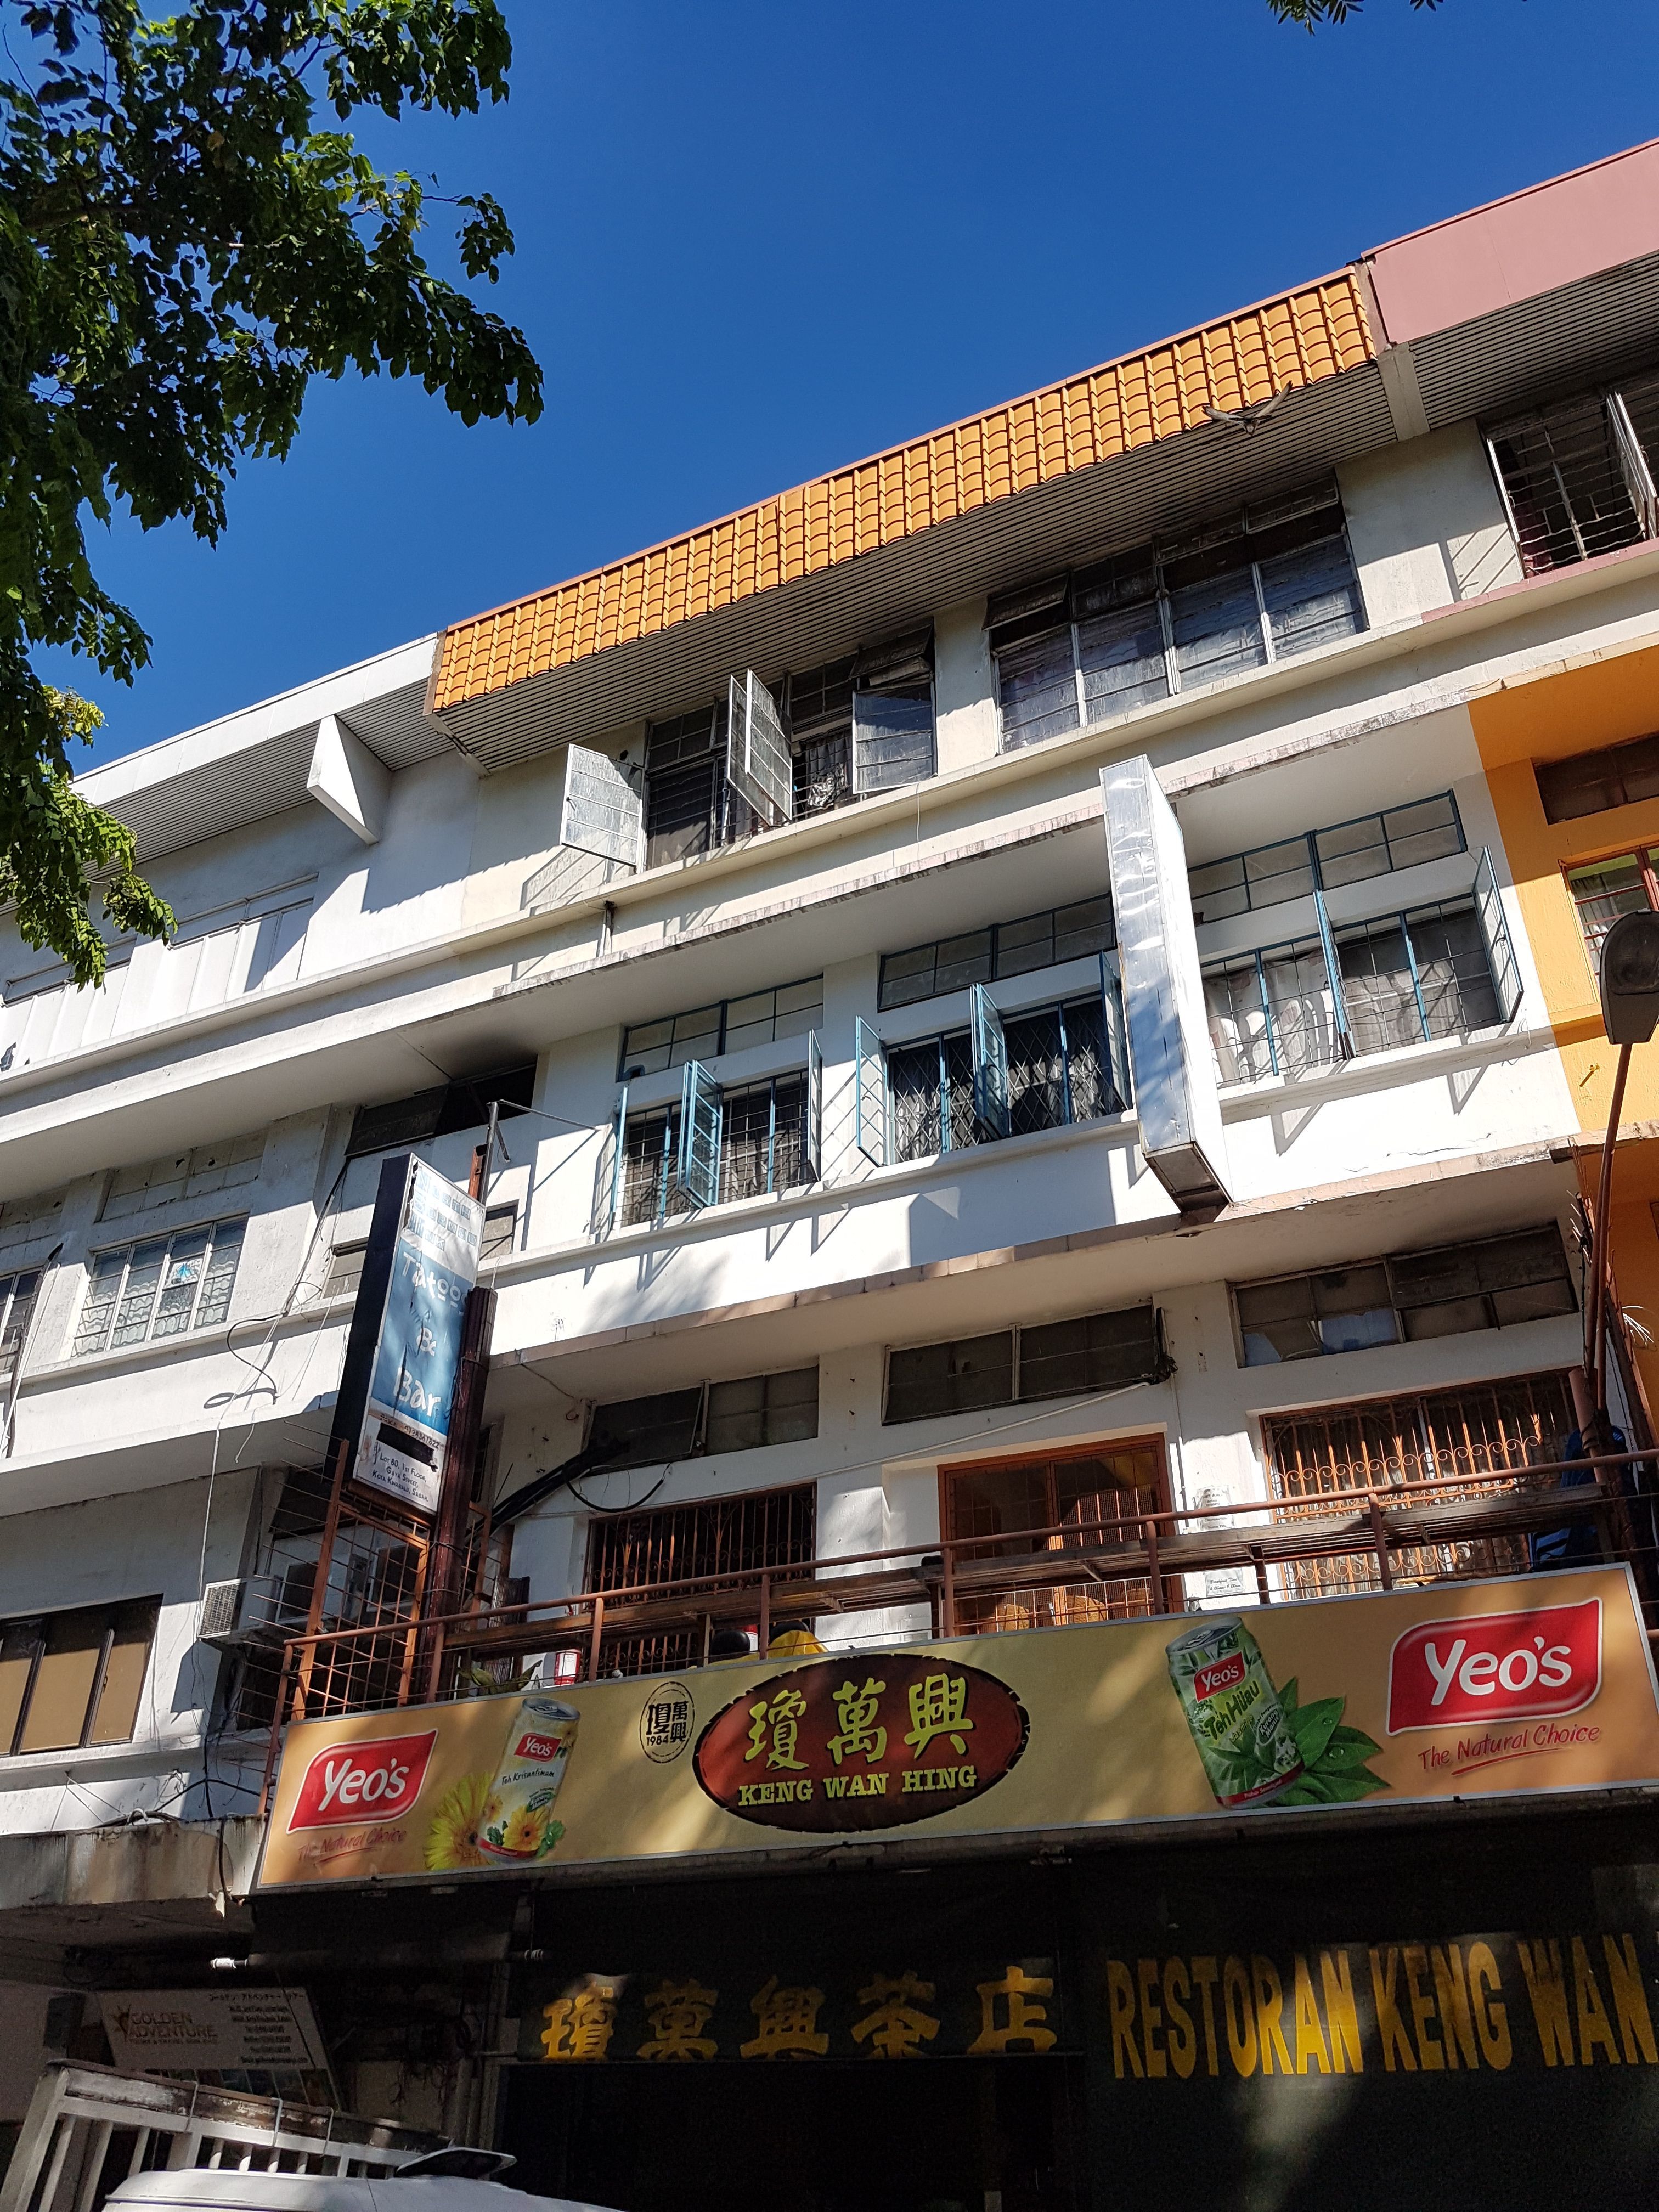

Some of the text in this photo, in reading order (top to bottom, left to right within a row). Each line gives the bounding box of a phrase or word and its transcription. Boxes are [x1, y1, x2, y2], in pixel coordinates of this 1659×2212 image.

[415, 1169, 471, 1221] NORTH
[412, 1189, 477, 1246] BORNEO
[416, 1327, 437, 1357] &
[393, 1367, 441, 1417] Bar
[1201, 1664, 1239, 1691] Yeo's
[1424, 1635, 1572, 1706] Yeo's
[744, 1673, 974, 1770] 瓊萬興
[1204, 1681, 1260, 1740] Teh Hijau
[1259, 1709, 1278, 1735] Kurang
[1265, 1717, 1279, 1739] Manis
[523, 1736, 552, 1757] Yeo's
[646, 1734, 669, 1746] 1984
[1418, 1723, 1601, 1770] The Natural Choice
[318, 1757, 410, 1812] Yeo's
[738, 1765, 977, 1807] KENG WAN HING
[297, 1826, 407, 1861] The Natural Choice
[131, 2011, 193, 2024] GOLDEN
[1106, 1933, 1659, 2079] RESTORAN KENG WAN
[130, 2024, 218, 2038] ADVENTURE
